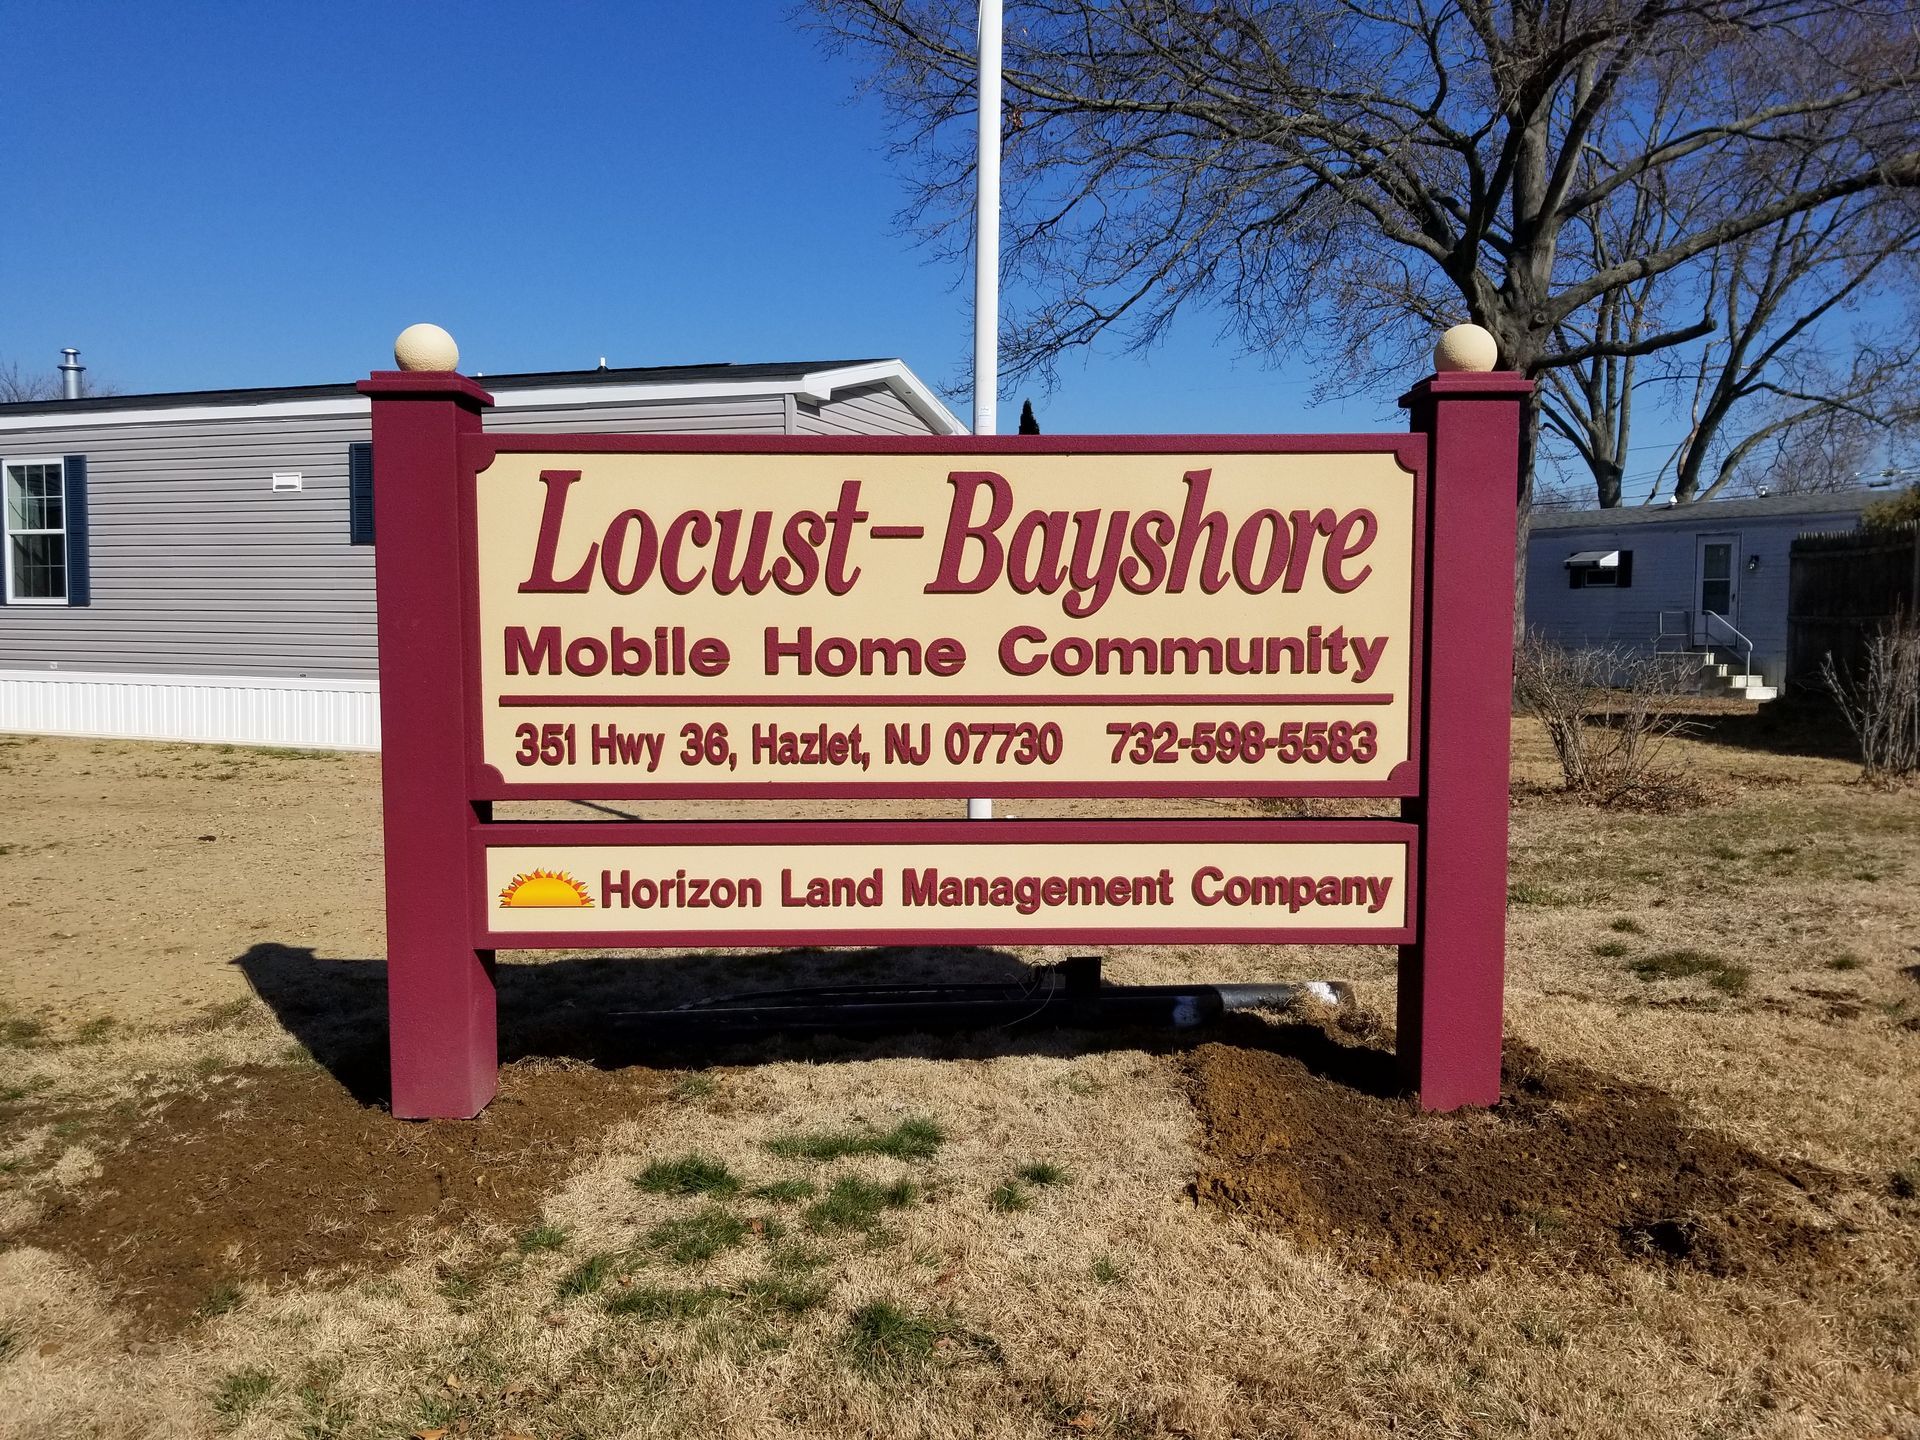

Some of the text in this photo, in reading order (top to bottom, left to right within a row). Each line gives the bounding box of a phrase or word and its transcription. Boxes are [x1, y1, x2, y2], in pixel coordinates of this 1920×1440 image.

[518, 468, 1378, 619] Locust-Bayshore
[504, 625, 1390, 684] Mobile Home Community
[515, 720, 1378, 773] 351 Hwy 36, Hazlet, NJ 07730 732-598-5583
[600, 865, 1393, 916] Horizon Land Management Company
